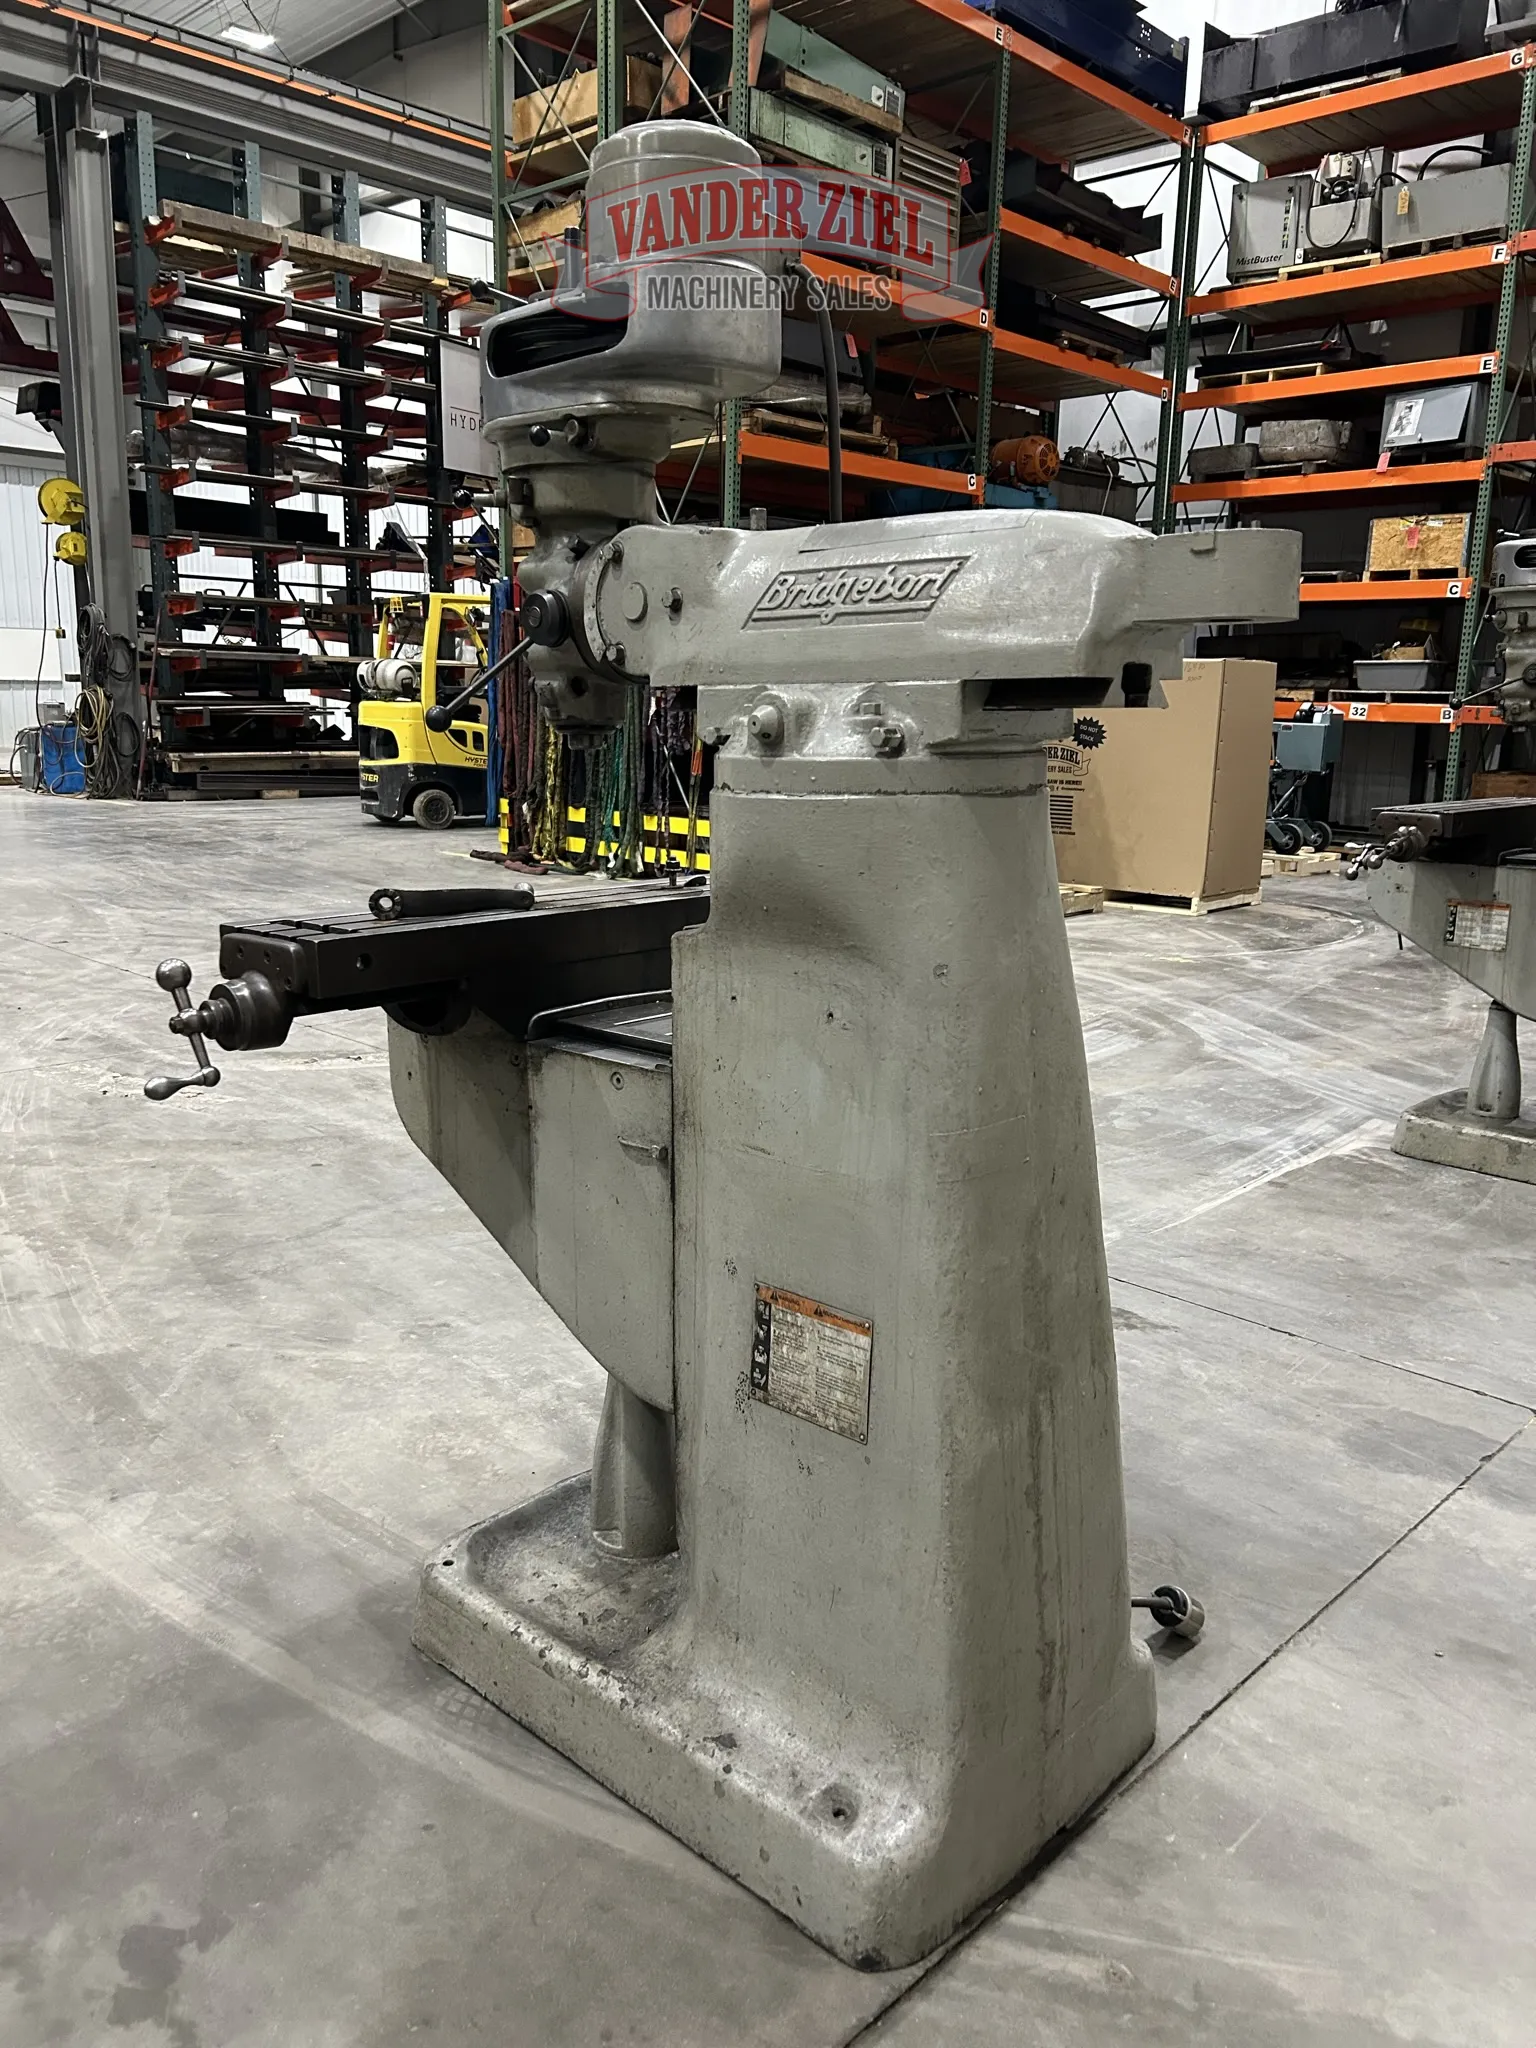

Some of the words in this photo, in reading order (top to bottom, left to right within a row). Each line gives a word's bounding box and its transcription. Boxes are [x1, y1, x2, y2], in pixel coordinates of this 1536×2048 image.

[996, 29, 1003, 41] E
[1511, 53, 1523, 65] G
[1183, 128, 1190, 139] F
[1494, 248, 1504, 260] F
[1236, 254, 1284, 267] MistBuster
[1170, 280, 1176, 291] E
[980, 312, 988, 324] D
[1482, 358, 1492, 371] E
[1162, 389, 1168, 400] D
[969, 476, 976, 487] C
[759, 560, 963, 624] Bridgeport
[1449, 584, 1459, 595] C
[1351, 706, 1366, 717] 32
[1442, 709, 1452, 720] B
[1080, 734, 1094, 742] STACK
[464, 756, 487, 764] HYSTE
[1060, 748, 1080, 765] ZIEL
[1058, 766, 1072, 774] SALES
